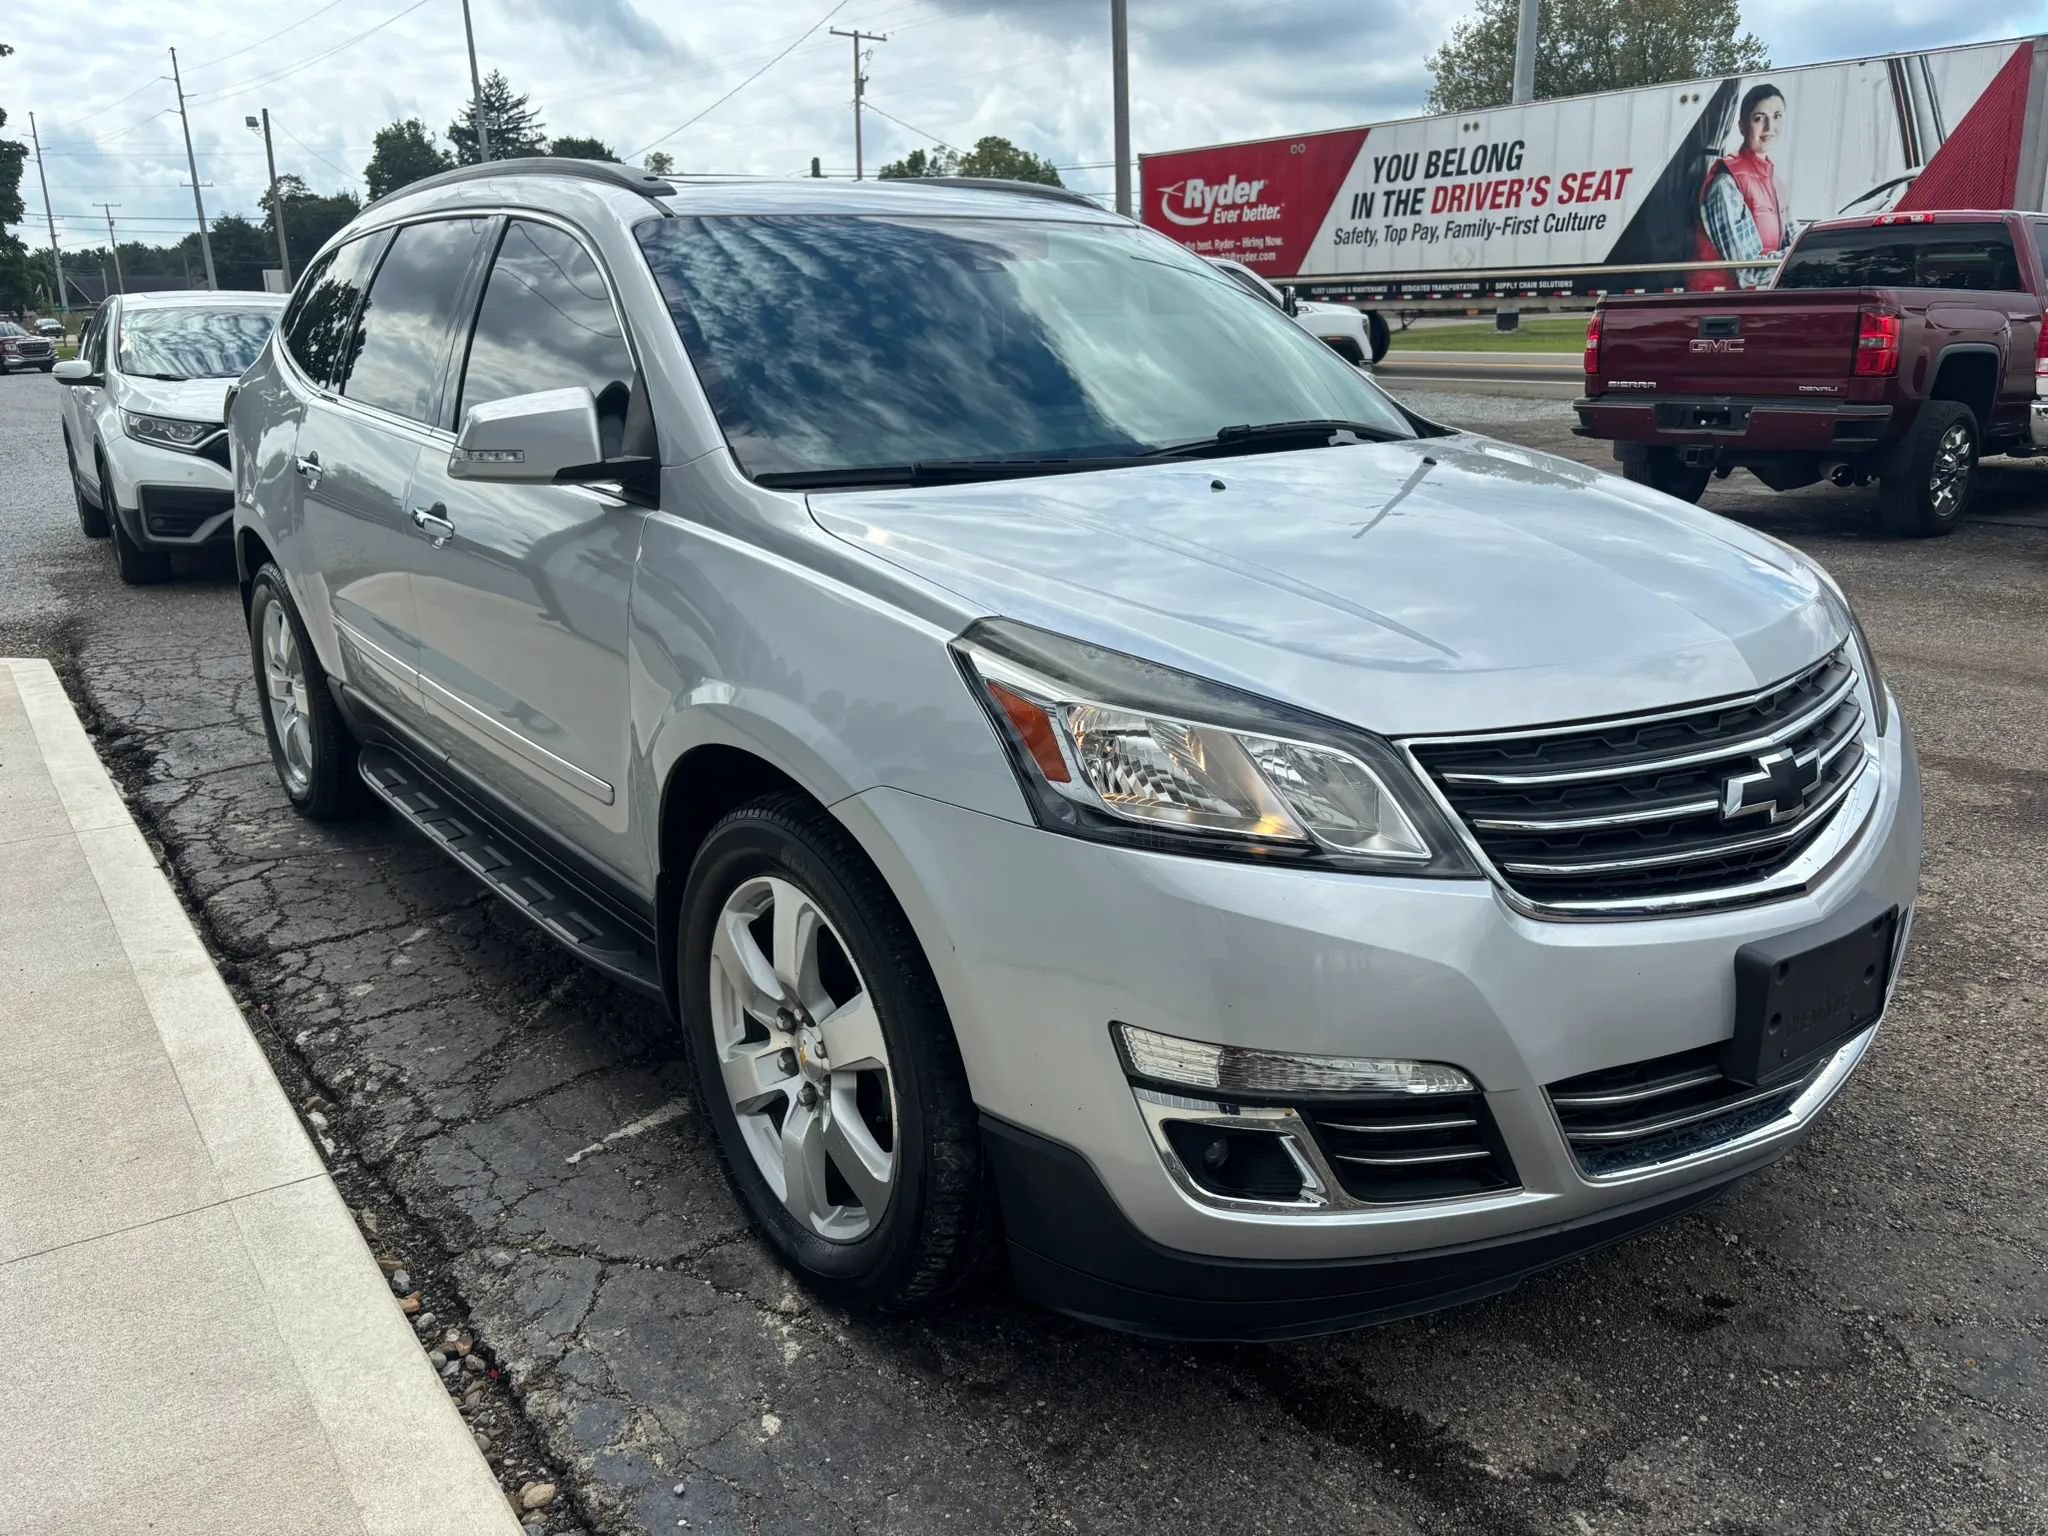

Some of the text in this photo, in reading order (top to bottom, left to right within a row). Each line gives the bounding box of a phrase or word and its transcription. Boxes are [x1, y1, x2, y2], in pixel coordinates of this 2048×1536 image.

[1373, 139, 1525, 184] YOU BELONG
[1184, 175, 1265, 214] Ryder
[1350, 167, 1633, 220] IN THE DRIVER'S SEAT
[1213, 204, 1281, 224] Ever better.
[1333, 212, 1607, 248] Safety, Top Pay, Family-First Culture
[1214, 238, 1235, 250] Ryder
[1242, 236, 1264, 249] Hiring
[1265, 236, 1284, 247] Now.
[1352, 285, 1388, 293] MAINTENANCE
[1401, 282, 1479, 292] DEDICATED TRANSPORTATION
[1519, 281, 1537, 289] CHAIN
[1539, 280, 1573, 288] SOLUTIONS
[1689, 338, 1745, 353] GMC
[1608, 380, 1657, 389] SIERRA
